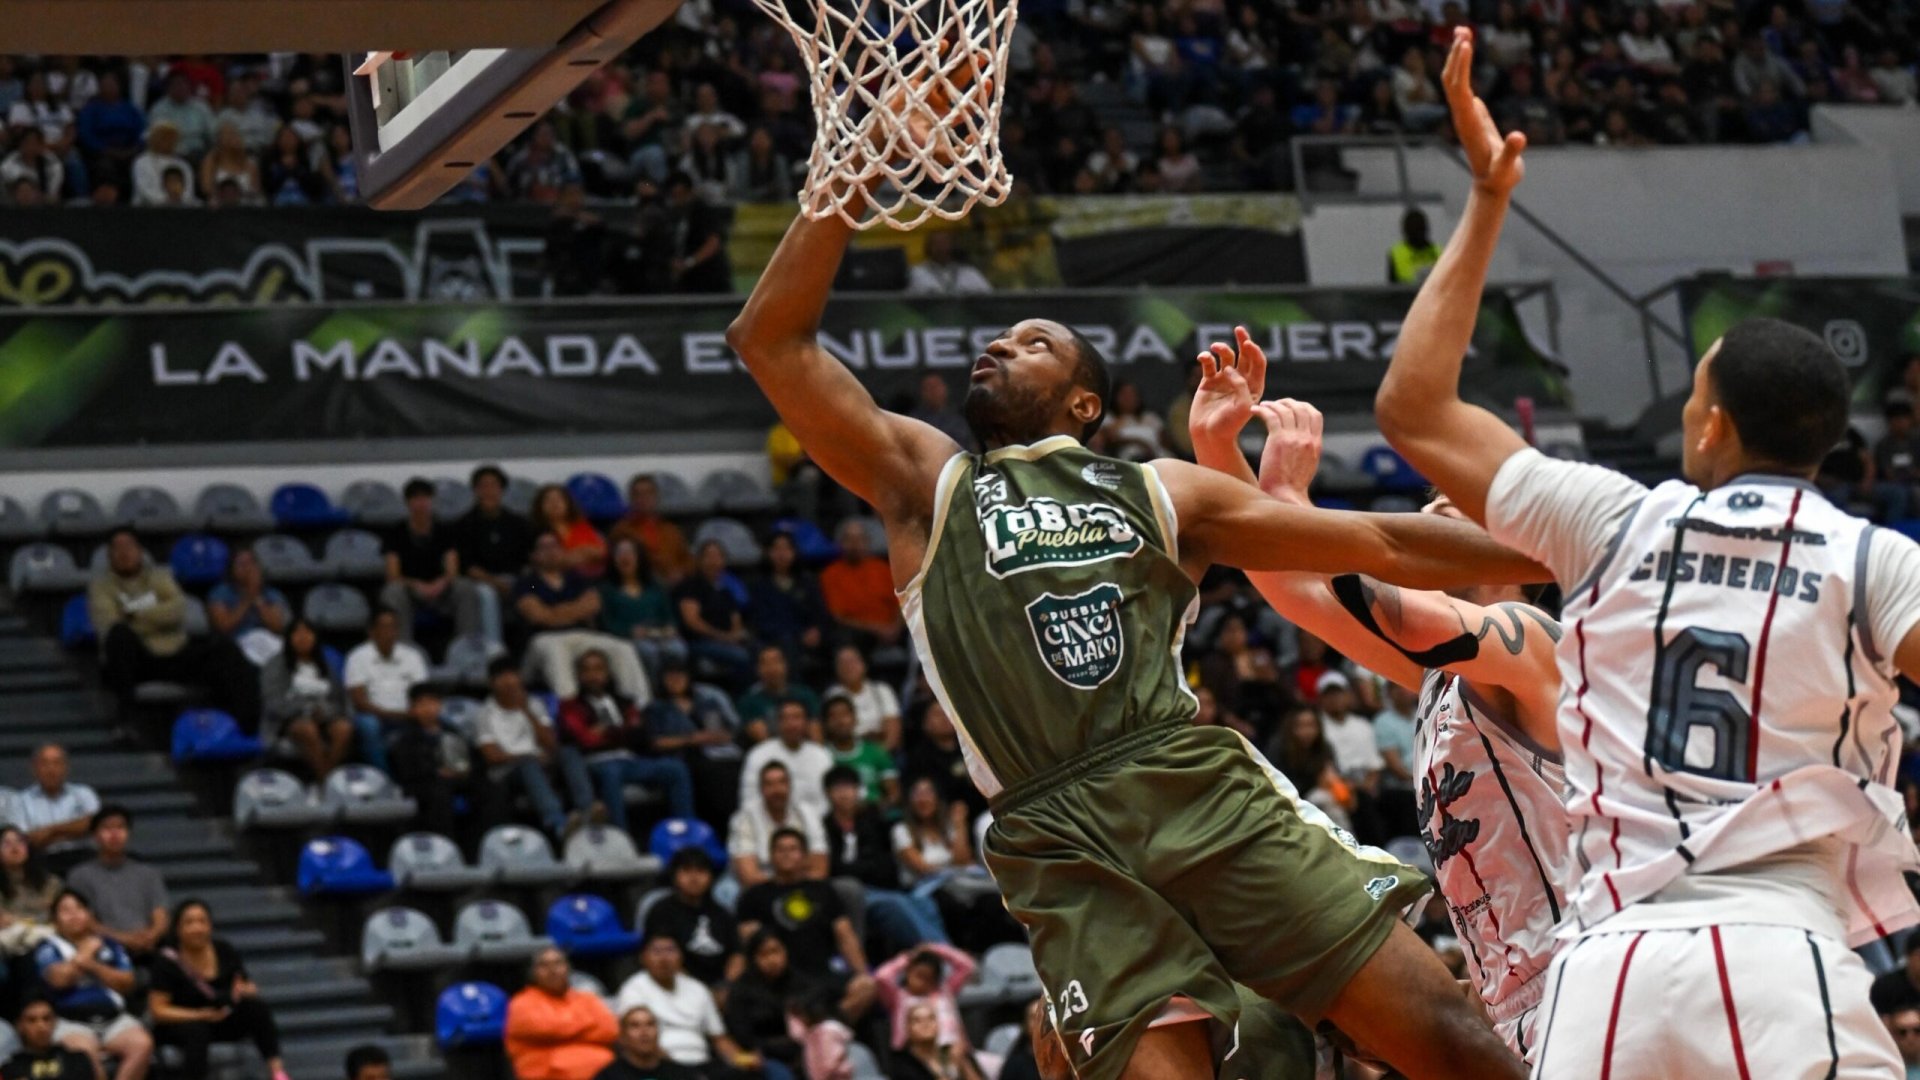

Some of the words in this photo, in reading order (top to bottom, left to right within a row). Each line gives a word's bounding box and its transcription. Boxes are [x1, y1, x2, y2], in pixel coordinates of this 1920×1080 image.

[150, 343, 267, 386] LA
[293, 334, 660, 382] MANADA
[683, 331, 751, 374] E
[1016, 523, 1108, 550] Puebla
[1629, 551, 1823, 604] CISNEROS
[1049, 600, 1110, 622] PUEBLA
[1645, 625, 1754, 784] 6
[1060, 979, 1090, 1023] 23
